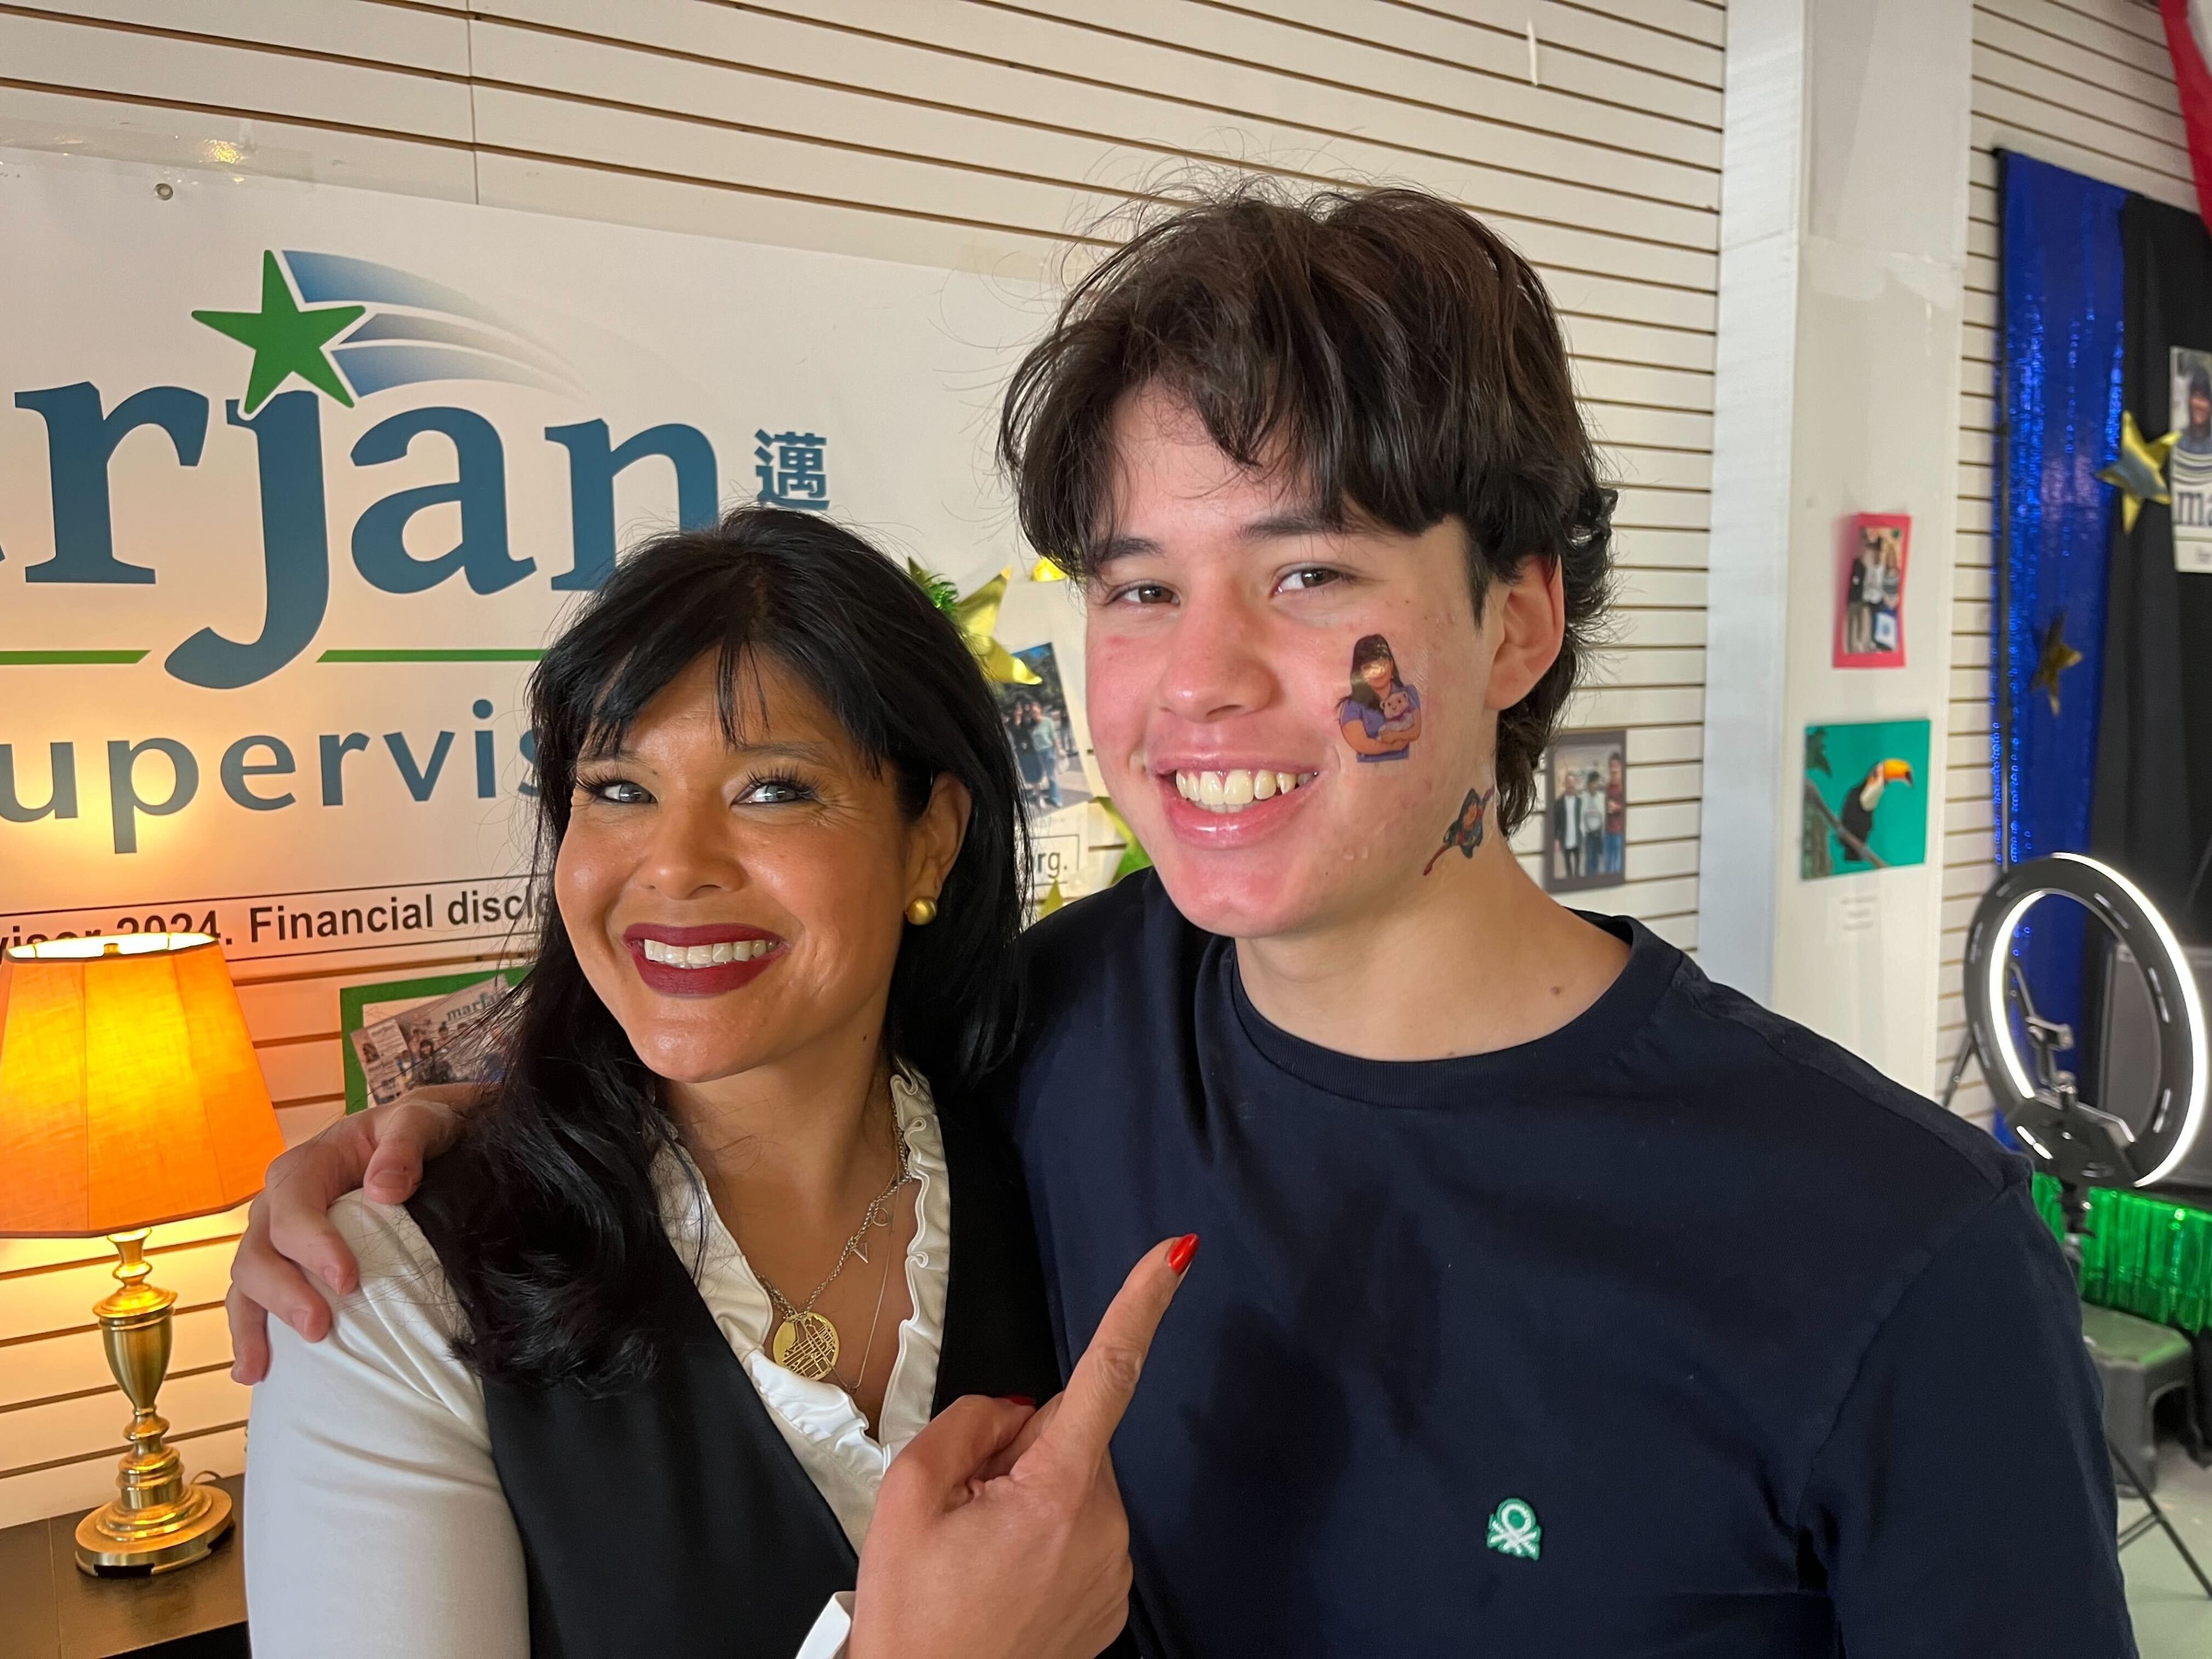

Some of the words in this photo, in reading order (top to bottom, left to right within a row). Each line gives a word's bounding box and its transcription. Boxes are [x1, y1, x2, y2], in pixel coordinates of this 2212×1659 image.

[755, 429, 830, 510] 邁
[0, 380, 718, 689] rjan
[2172, 492, 2212, 527] m
[250, 893, 432, 942] Financial
